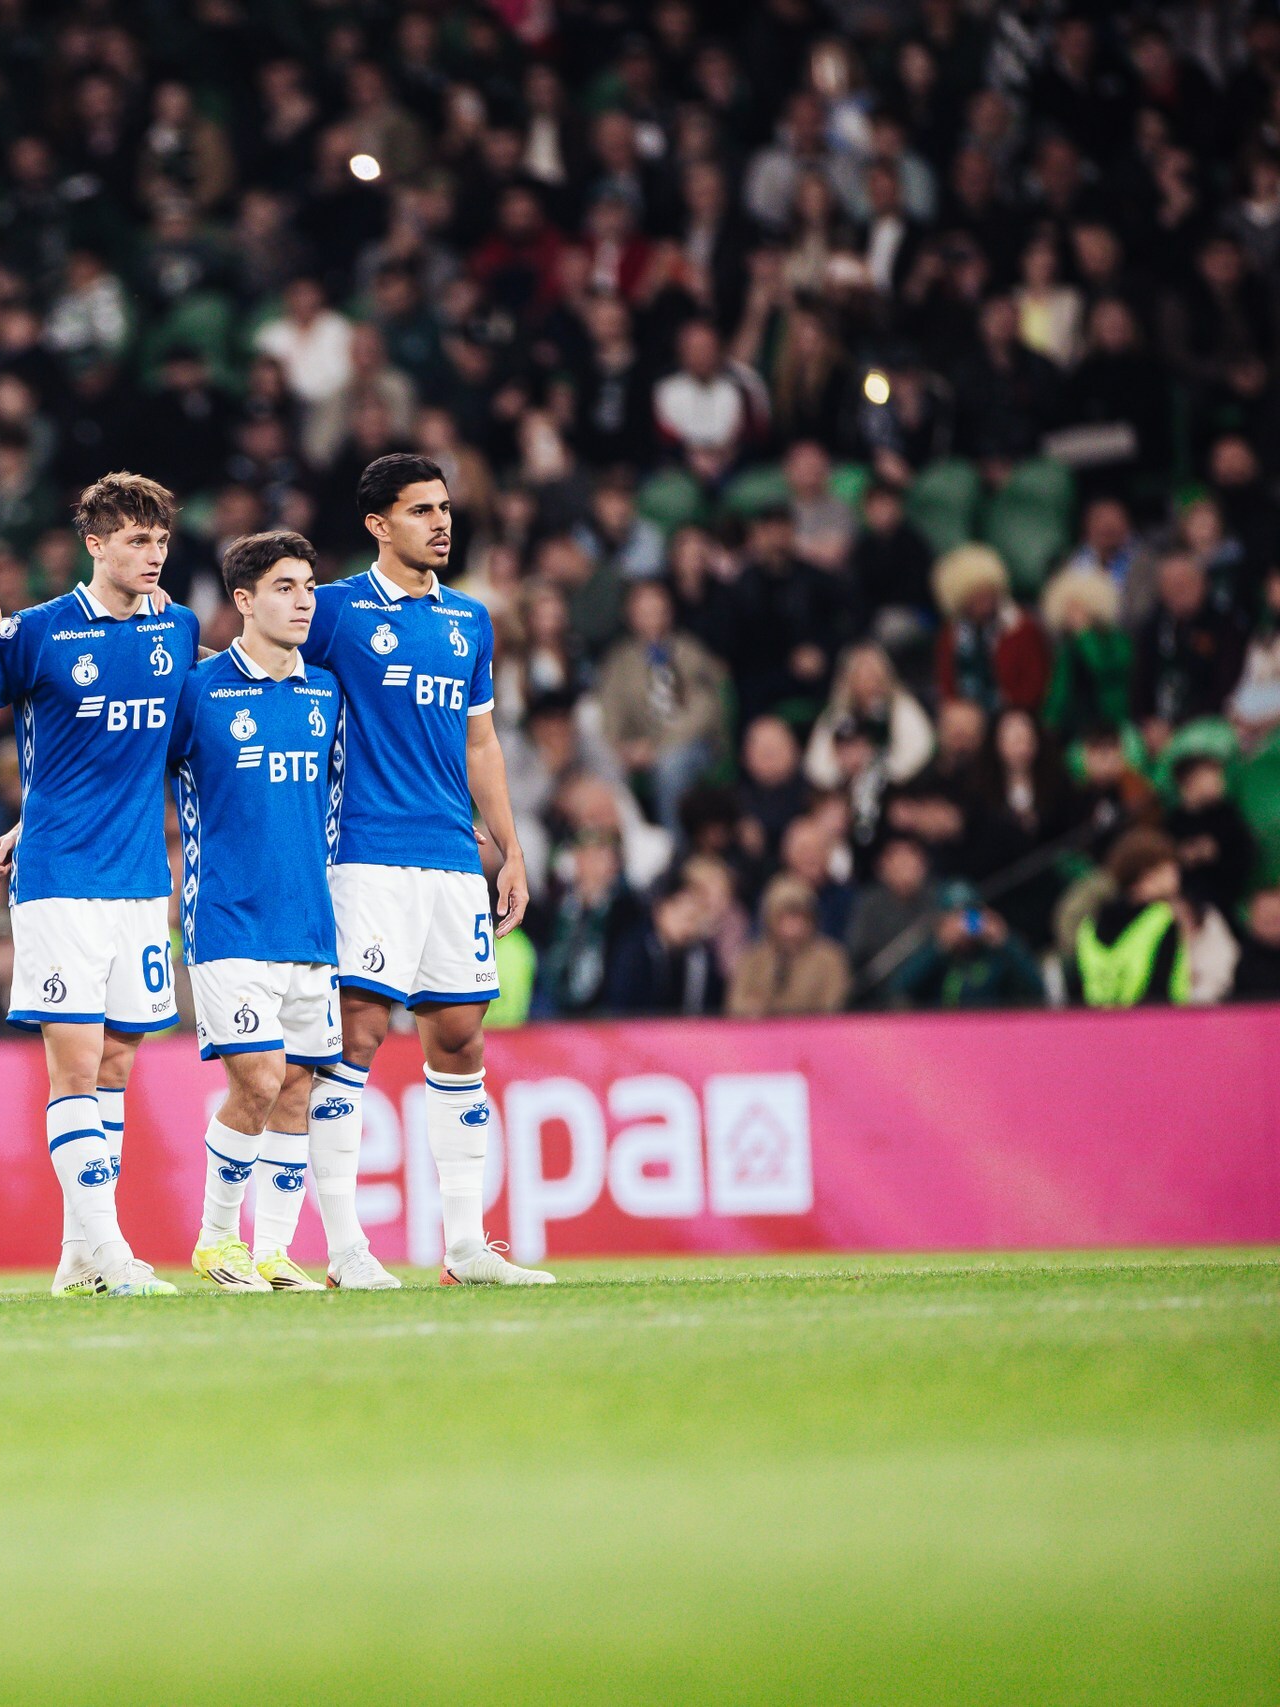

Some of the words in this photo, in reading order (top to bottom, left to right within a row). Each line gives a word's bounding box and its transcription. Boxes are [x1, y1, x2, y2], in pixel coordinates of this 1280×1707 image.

[431, 606, 473, 619] CHANGAN
[52, 628, 106, 641] wildberries
[210, 686, 264, 699] wildberries
[293, 686, 333, 698] CHANGAN
[415, 674, 466, 711] ВТБ
[107, 696, 167, 732] ВТБ
[269, 751, 319, 783] ВТБ
[63, 1278, 93, 1292] NEMESIS
